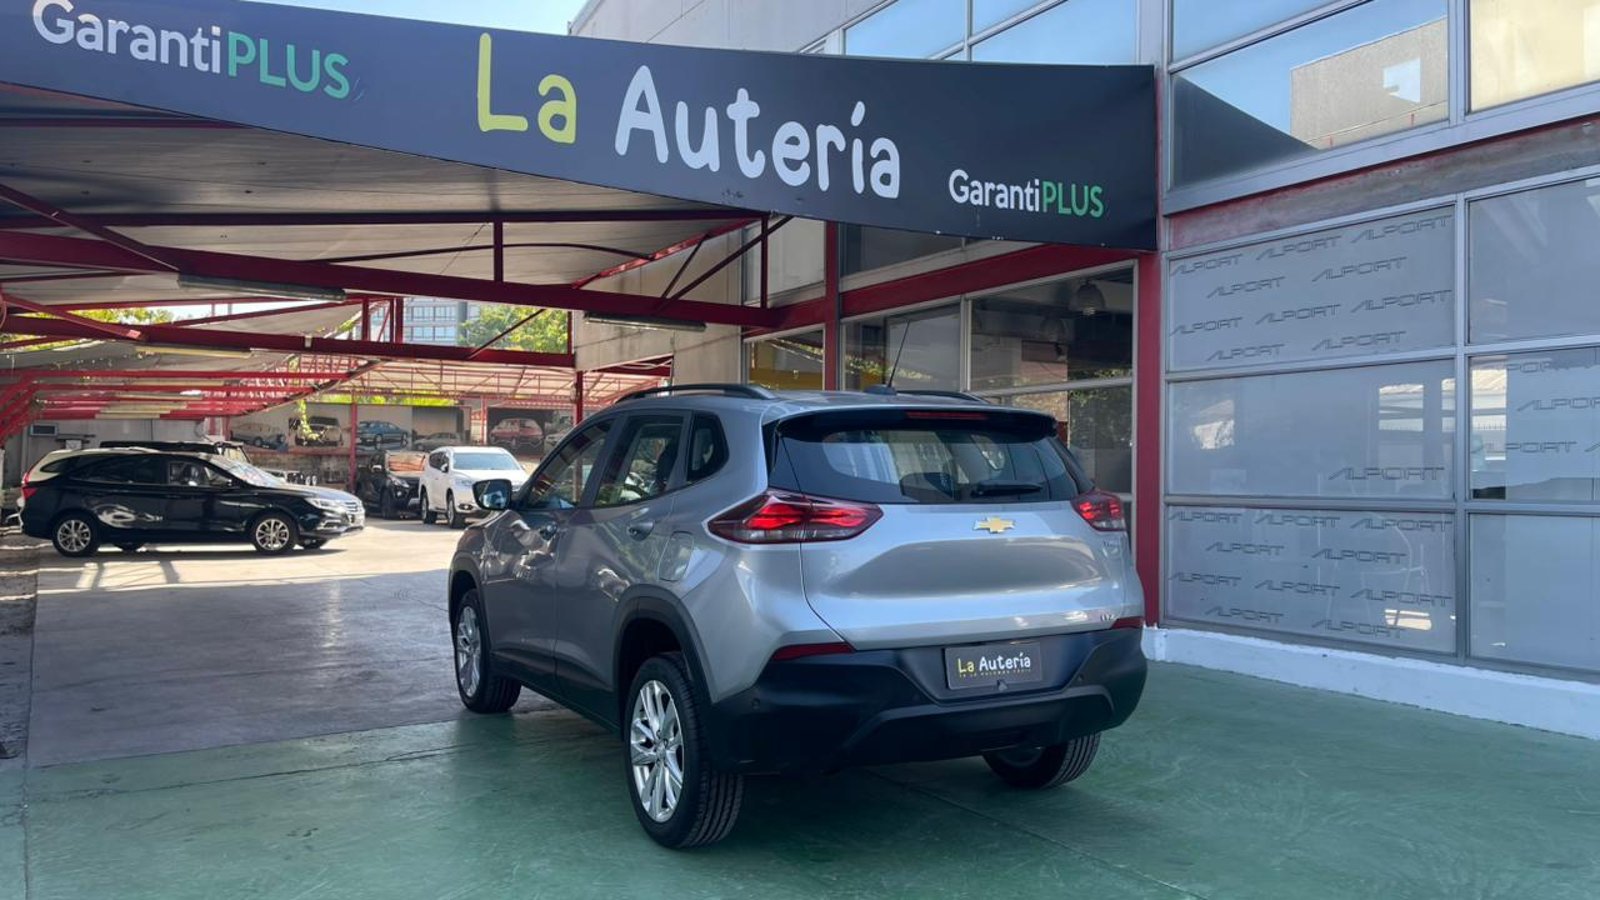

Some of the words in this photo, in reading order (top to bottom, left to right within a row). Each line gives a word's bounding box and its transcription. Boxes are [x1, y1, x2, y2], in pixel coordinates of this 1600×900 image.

[32, 0, 350, 99] GarantiPLUS
[477, 33, 577, 145] La
[614, 64, 900, 199] Autería
[948, 170, 1104, 218] GarantiPLUS
[957, 658, 975, 673] La
[979, 652, 1031, 671] Autería
